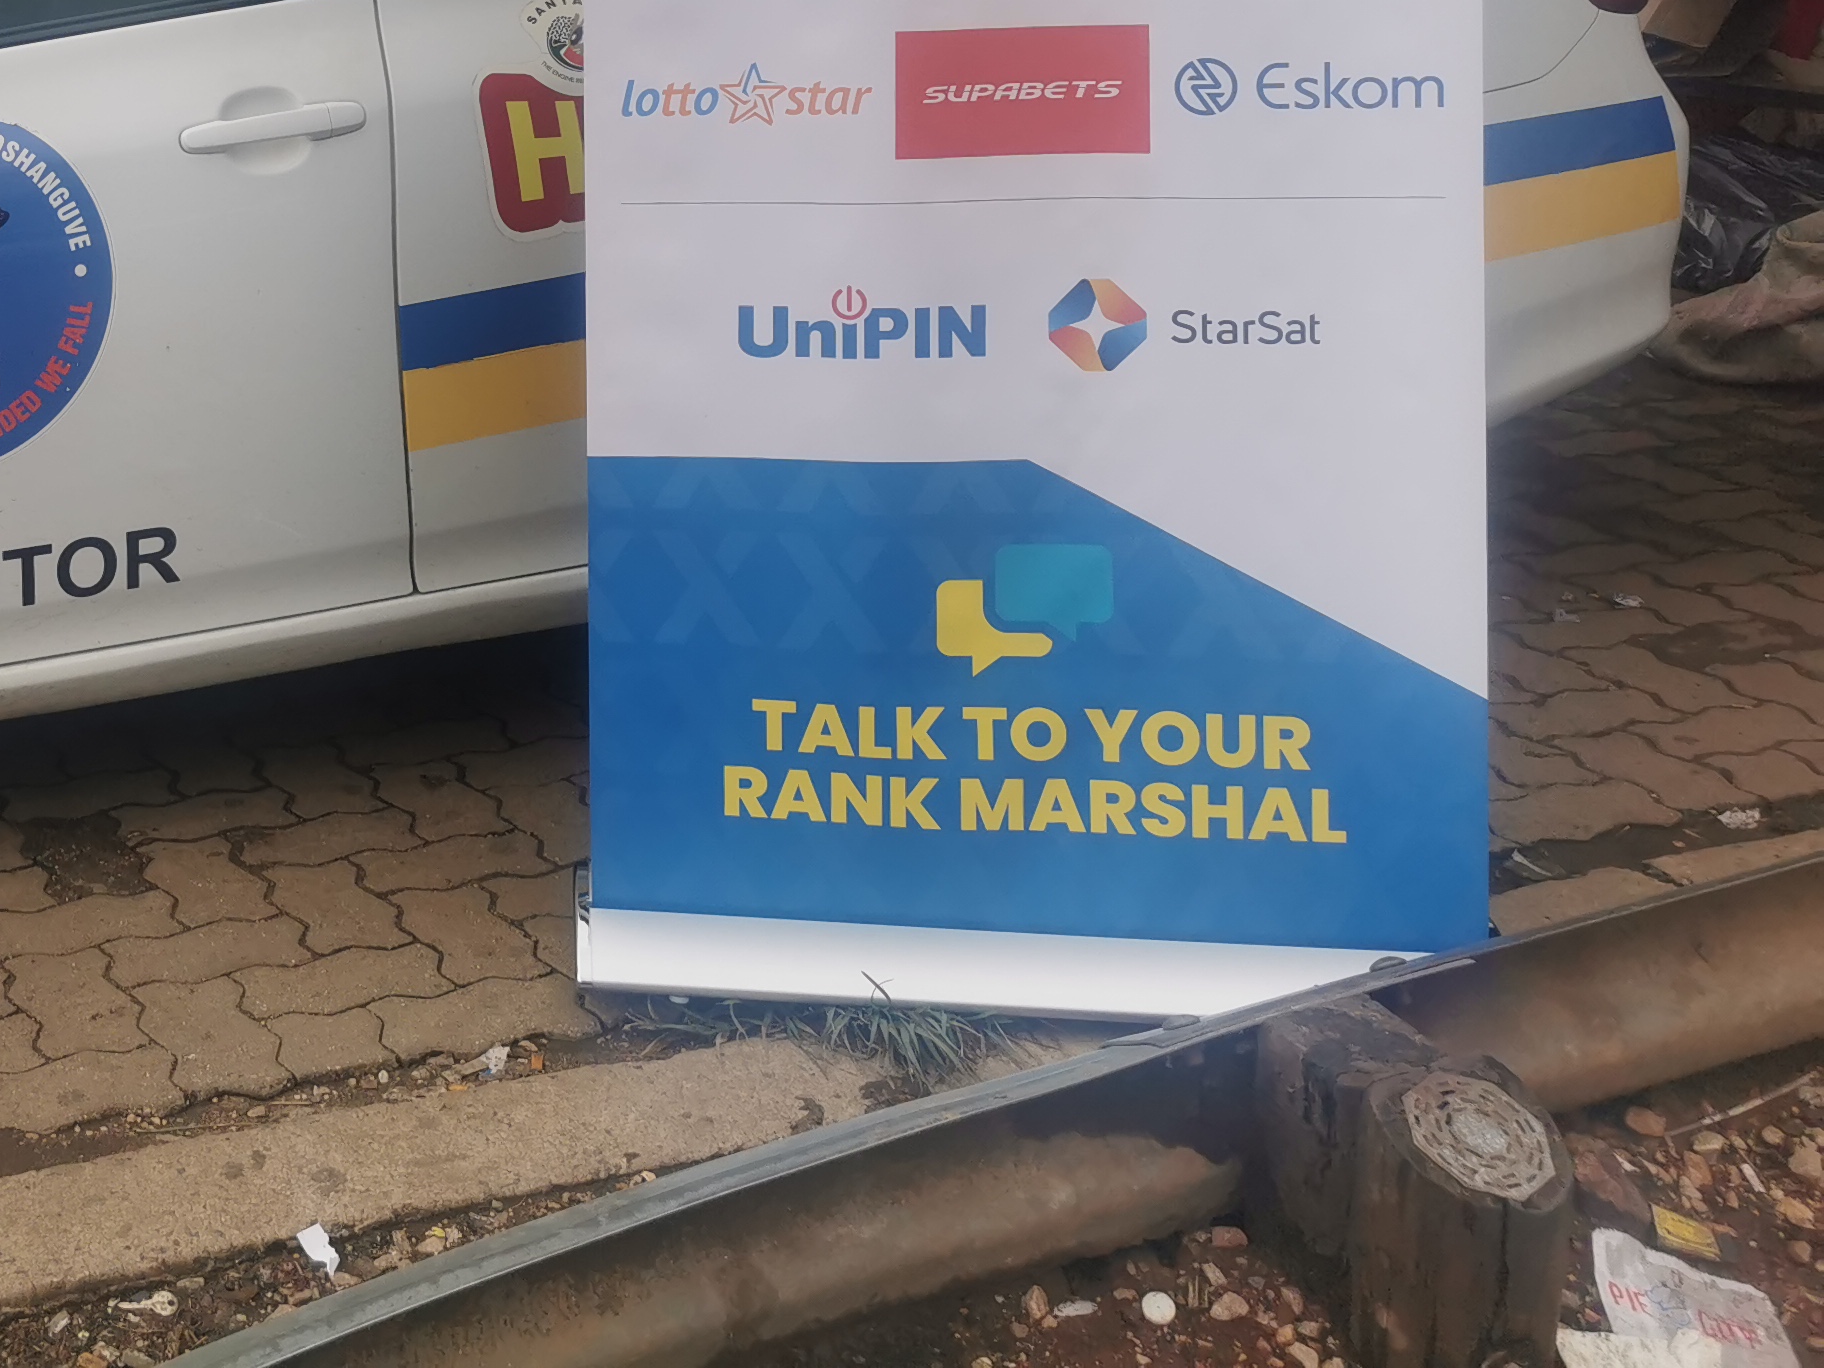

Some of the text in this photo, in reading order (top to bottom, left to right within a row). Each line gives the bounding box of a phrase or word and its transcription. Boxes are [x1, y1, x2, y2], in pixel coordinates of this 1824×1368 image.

[922, 79, 1122, 106] SUPABETS
[1256, 62, 1445, 112] Eskom
[34, 355, 72, 393] WE
[57, 301, 94, 356] FALL
[737, 304, 987, 360] UniPIN
[1171, 309, 1322, 347] StarSat
[751, 698, 1312, 771] TALK TO YOUR
[723, 765, 1348, 845] RANK MARSHAL
